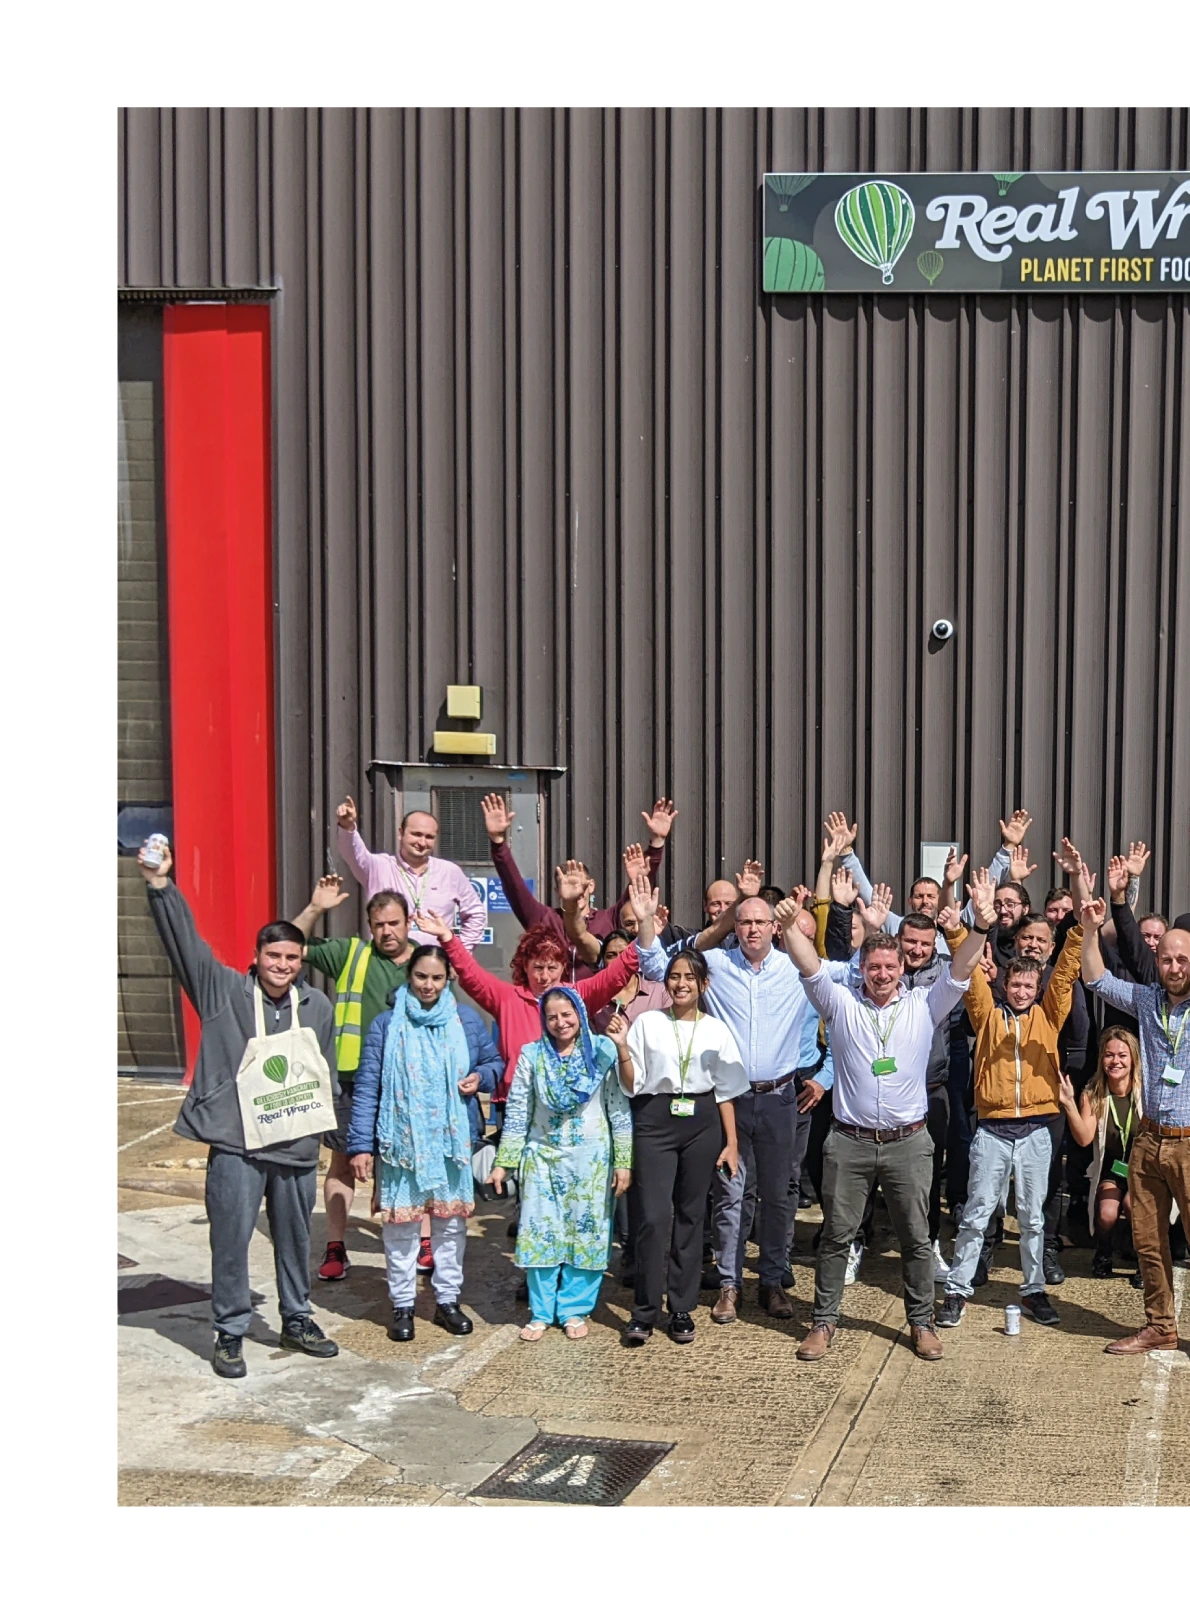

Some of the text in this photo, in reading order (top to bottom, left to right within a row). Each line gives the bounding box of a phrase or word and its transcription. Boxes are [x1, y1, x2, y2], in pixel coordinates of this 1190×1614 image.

[926, 186, 1080, 262] Real
[1020, 258, 1093, 282] PLANET
[1100, 258, 1154, 282] FIRST
[257, 1109, 282, 1124] Real
[283, 1103, 309, 1117] Wrap
